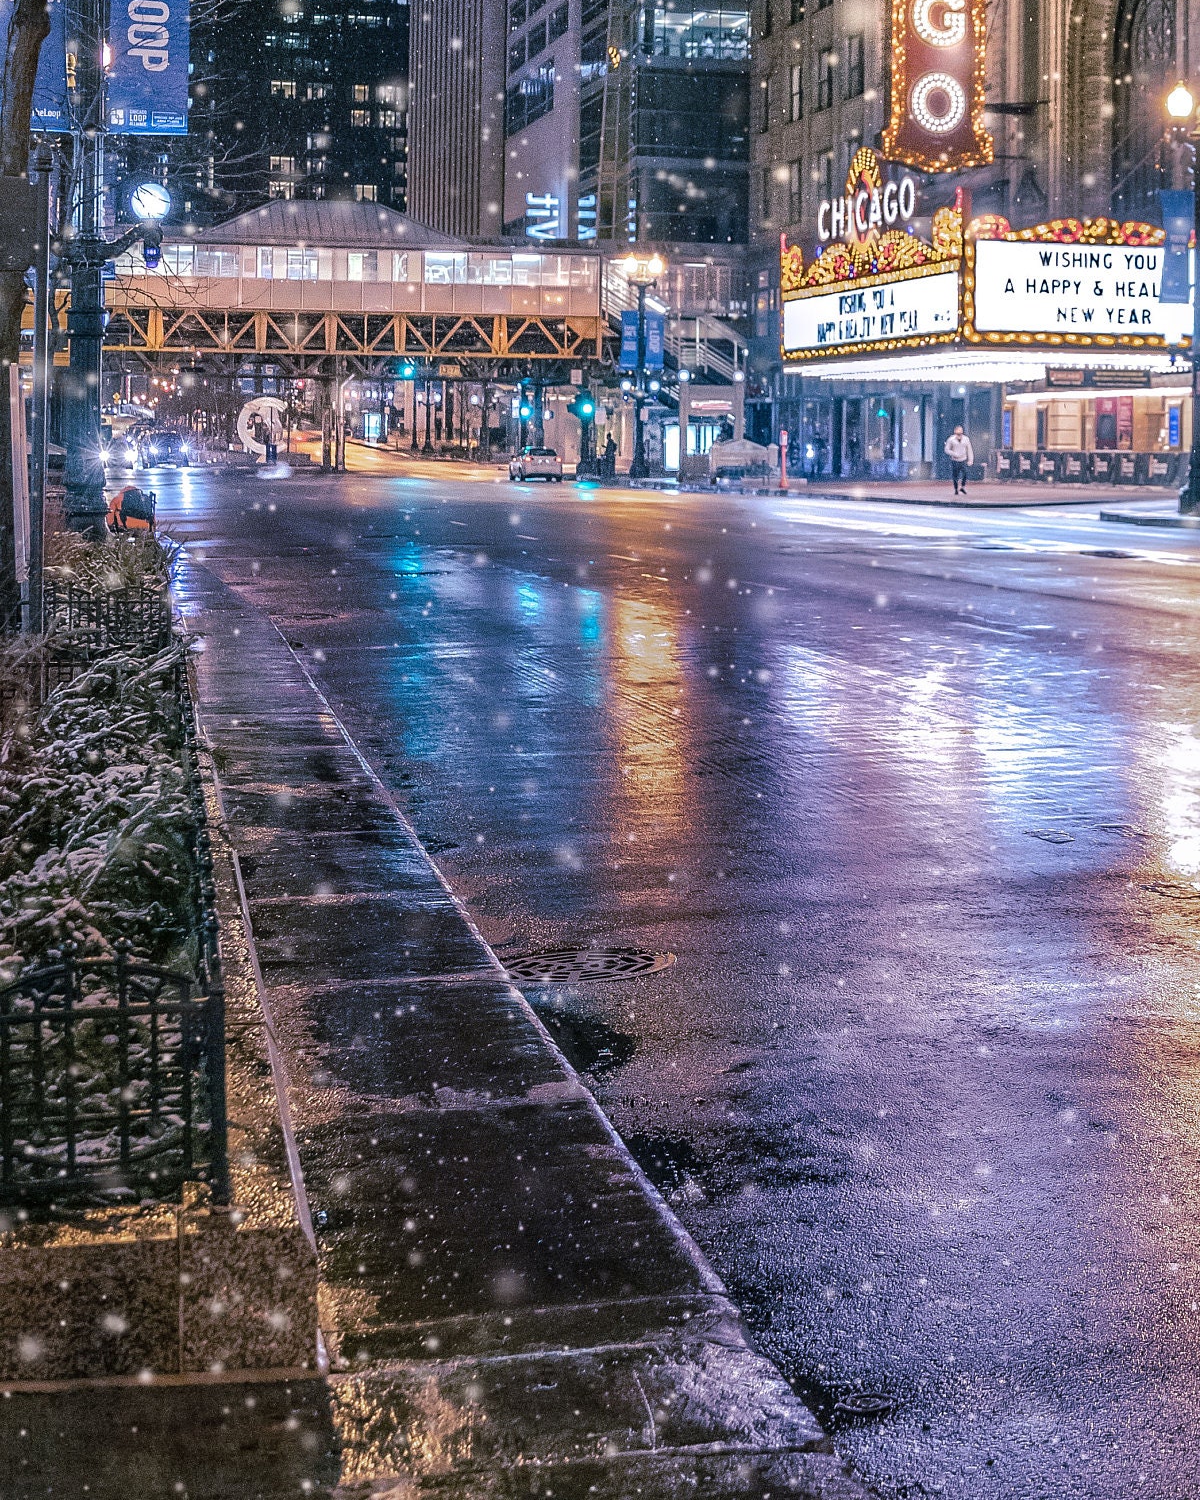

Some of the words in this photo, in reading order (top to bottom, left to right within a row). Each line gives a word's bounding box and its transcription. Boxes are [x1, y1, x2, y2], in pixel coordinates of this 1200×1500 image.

[129, 114, 147, 122] LOOP
[817, 175, 916, 242] CHICAGO
[1038, 251, 1113, 270] WISHING
[1124, 253, 1157, 270] YOU
[1004, 278, 1015, 294] A
[1025, 277, 1082, 296] HAPPY
[1093, 280, 1104, 297] &
[1056, 306, 1095, 323] NEW
[1106, 308, 1152, 325] YEAR
